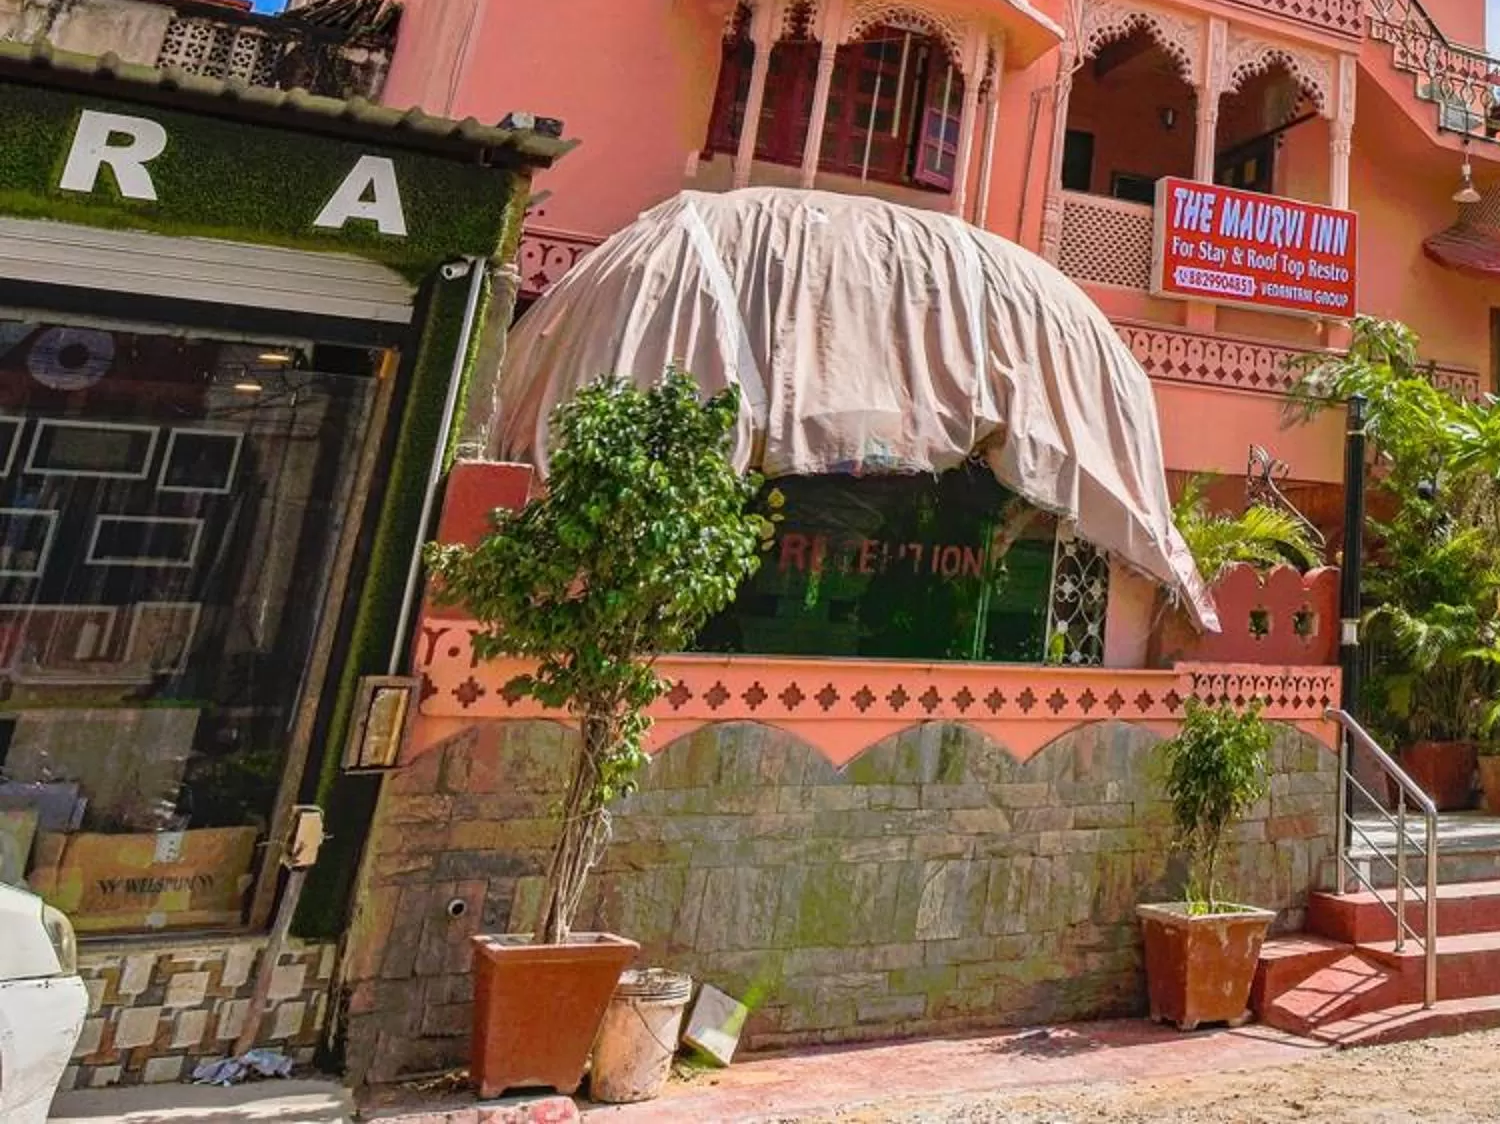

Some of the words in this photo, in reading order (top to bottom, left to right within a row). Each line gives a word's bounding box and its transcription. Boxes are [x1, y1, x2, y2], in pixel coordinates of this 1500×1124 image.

[1174, 187, 1216, 233] THE
[1219, 197, 1306, 249] MAURVI
[1309, 213, 1349, 256] INN
[1172, 236, 1194, 258] For
[1199, 241, 1228, 268] Stay
[1232, 246, 1243, 266] &
[1247, 249, 1278, 271] Roof
[1281, 254, 1304, 281] Top
[1308, 259, 1349, 283] Restro
[1314, 290, 1349, 308] GROUP
